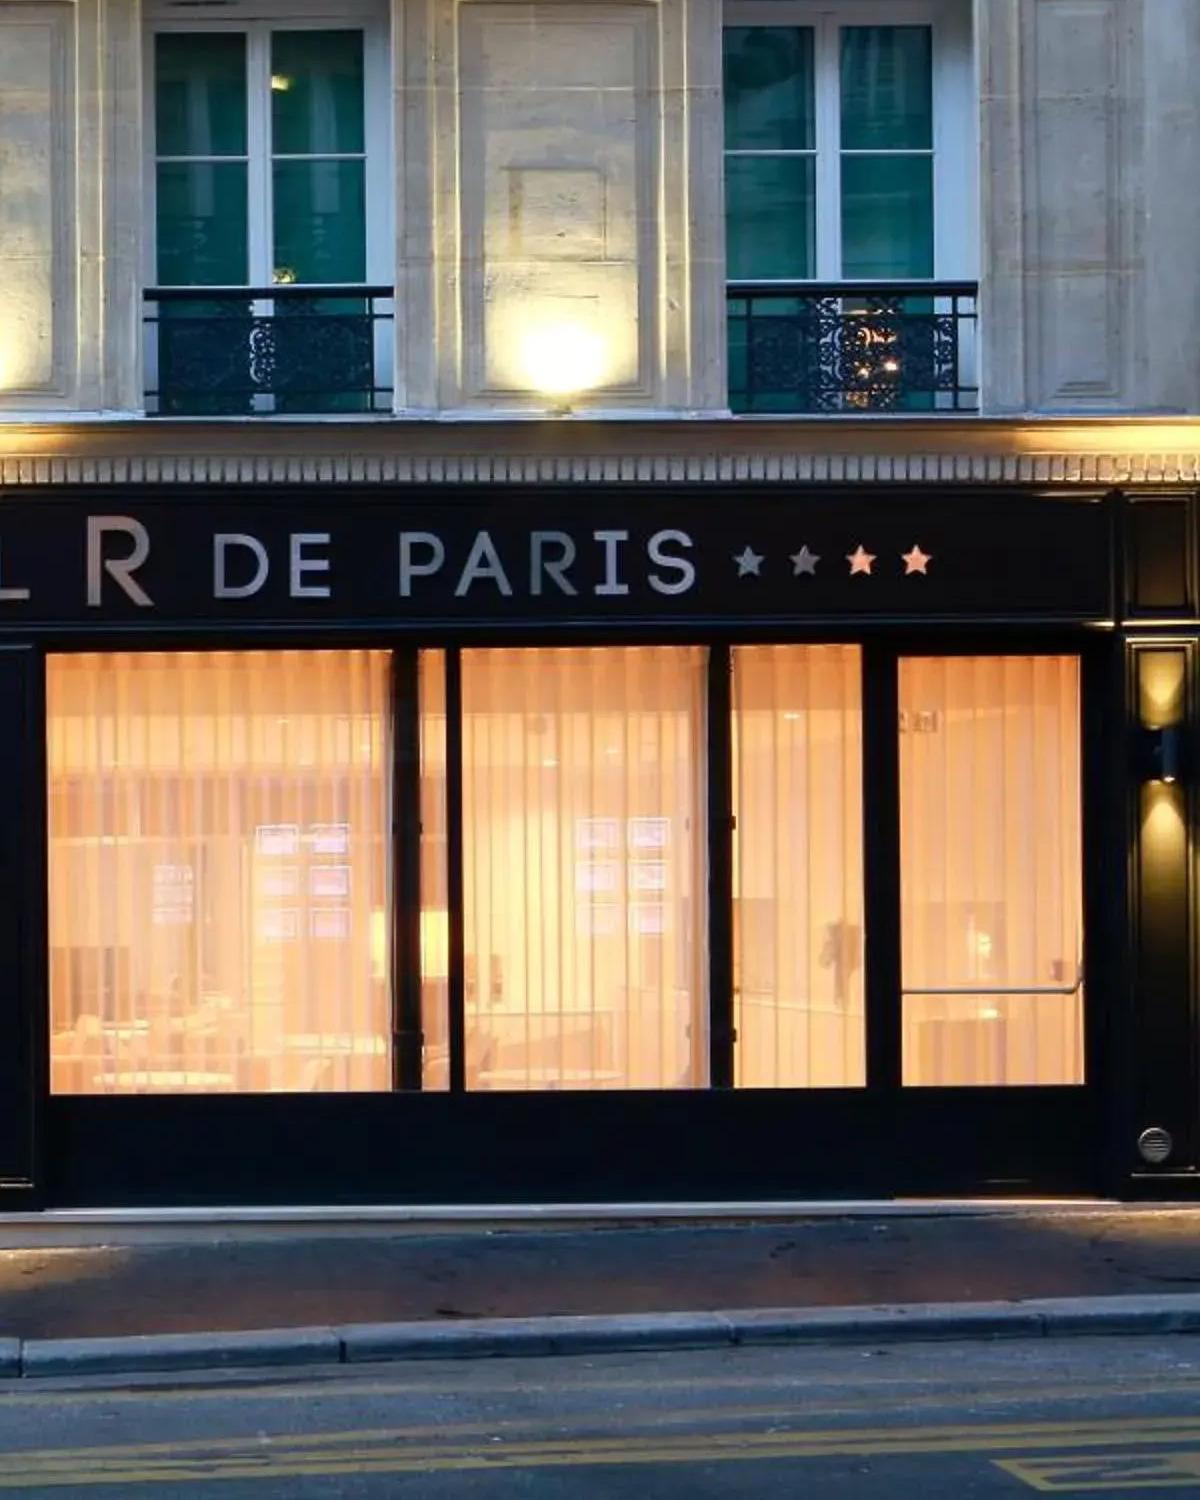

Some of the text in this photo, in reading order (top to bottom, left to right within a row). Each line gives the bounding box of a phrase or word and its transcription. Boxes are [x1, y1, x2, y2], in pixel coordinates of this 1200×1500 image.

[87, 515, 154, 607] R
[214, 533, 331, 598] DE
[400, 529, 695, 597] PARIS
